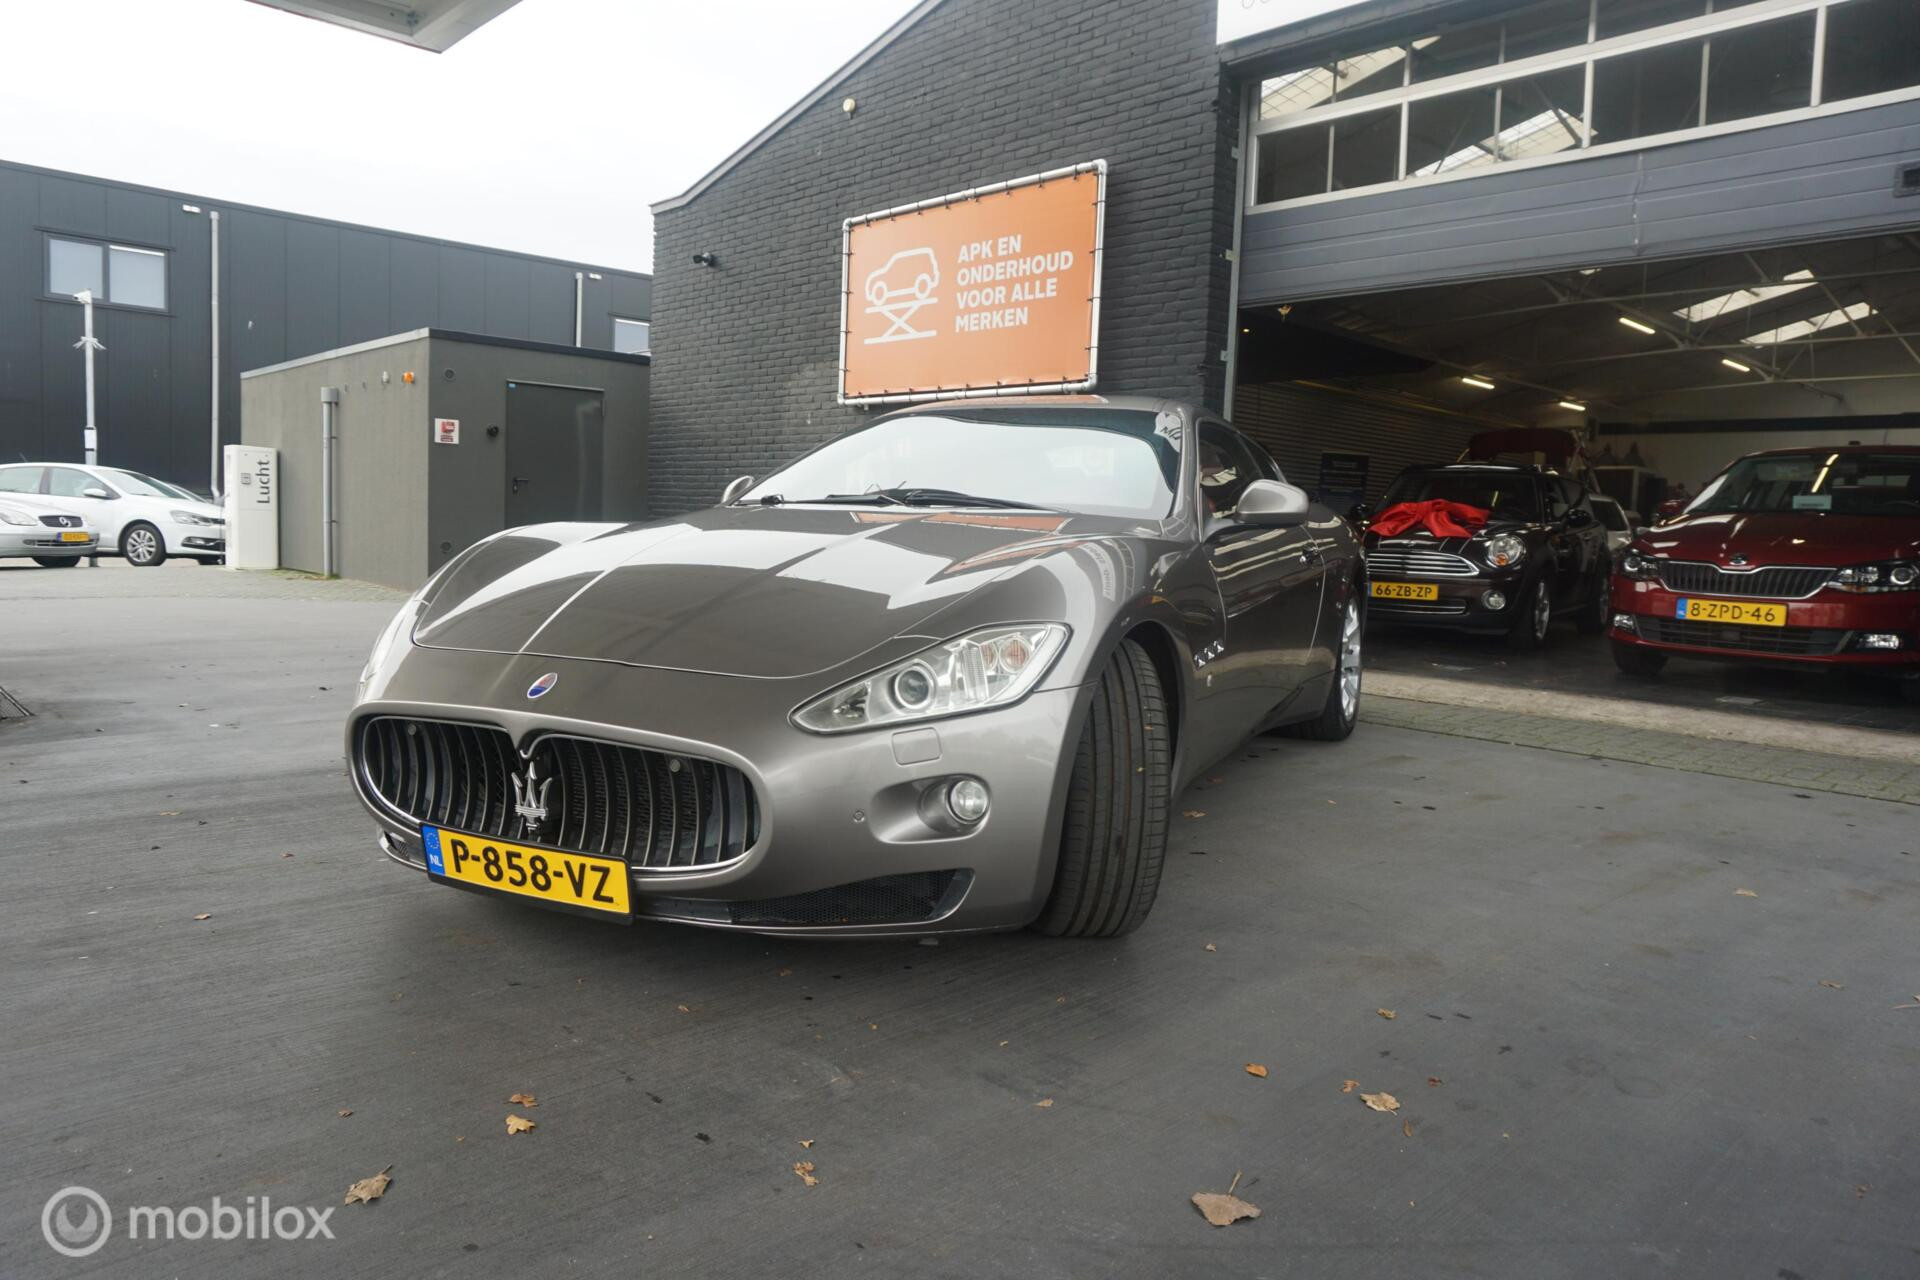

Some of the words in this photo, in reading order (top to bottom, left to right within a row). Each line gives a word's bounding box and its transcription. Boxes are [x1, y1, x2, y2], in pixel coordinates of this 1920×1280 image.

[957, 239, 993, 263] APK
[997, 234, 1022, 256] EN
[956, 250, 1074, 286] ONDERHOUD
[956, 286, 1007, 309] VOOR
[1011, 277, 1058, 302] ALLE
[955, 306, 1029, 333] MERKEN
[255, 460, 270, 503] Lucht
[1375, 584, 1433, 598] 66-ZB-ZP
[1690, 602, 1776, 622] 8-ZPD-46
[429, 854, 443, 867] NL
[450, 838, 615, 904] P-858-VZ
